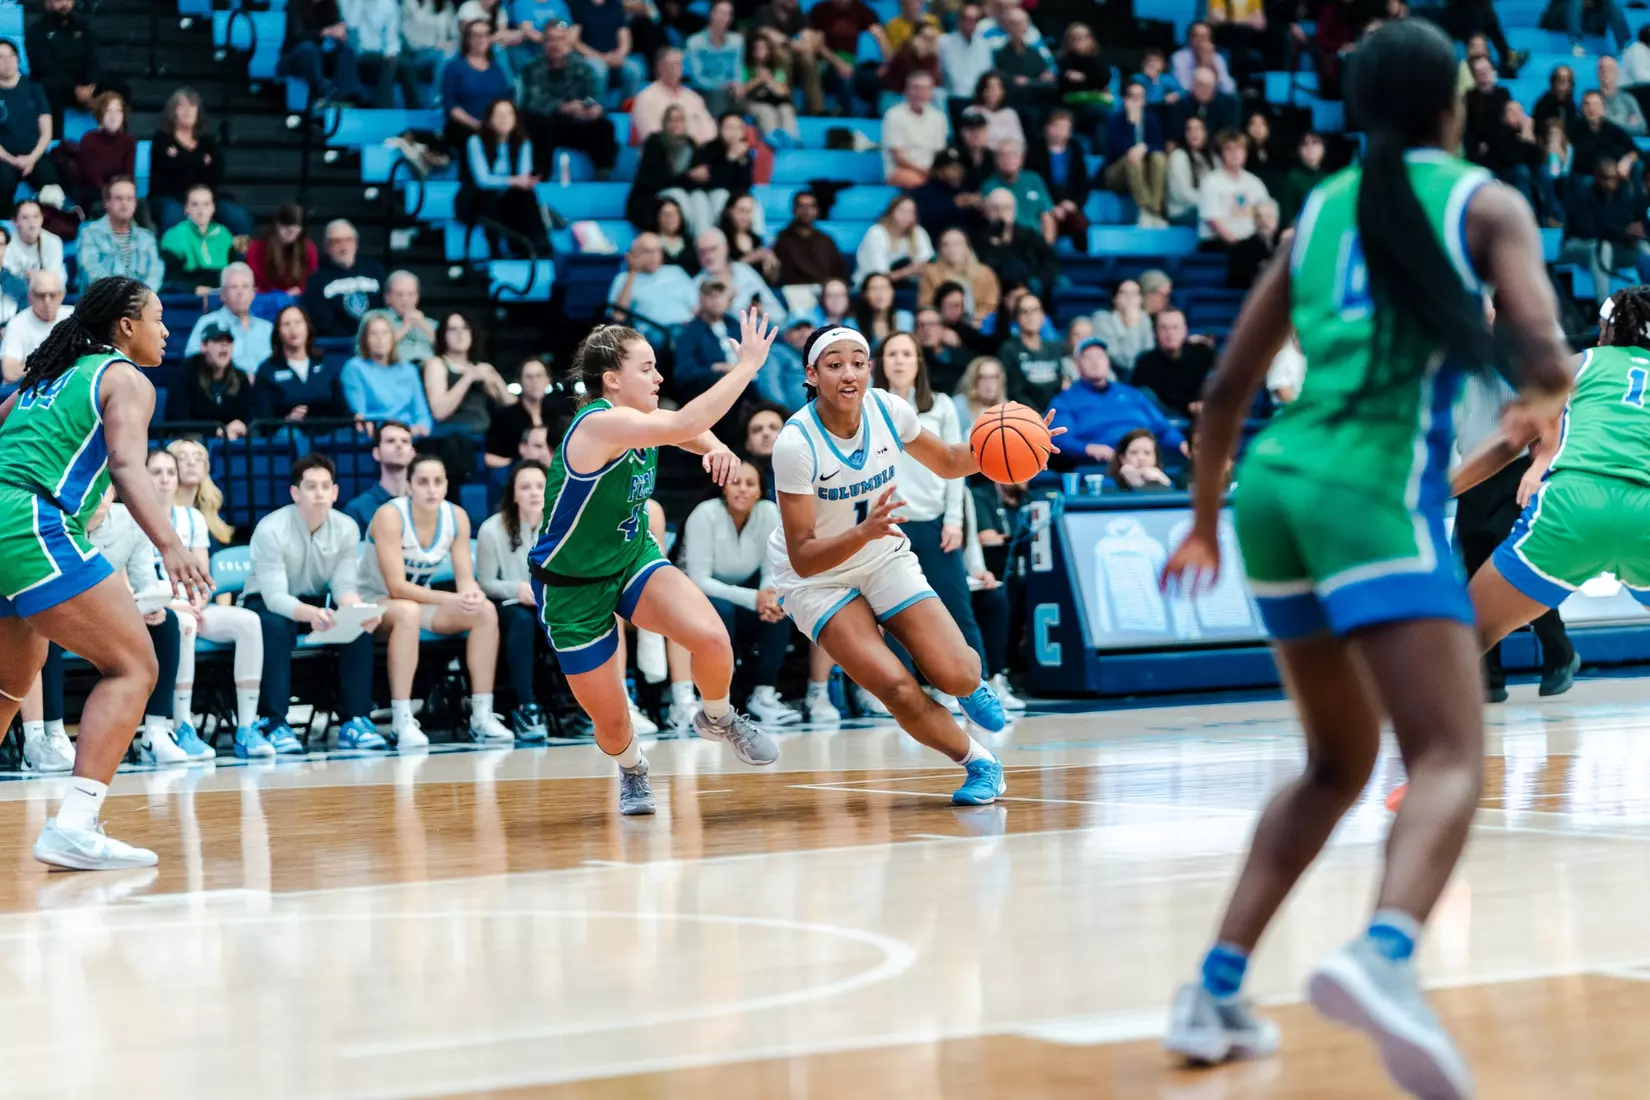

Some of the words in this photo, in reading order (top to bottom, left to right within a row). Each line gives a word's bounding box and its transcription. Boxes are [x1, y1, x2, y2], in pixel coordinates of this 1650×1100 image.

[1621, 366, 1648, 409] 1
[817, 465, 895, 501] COLUMBIA
[617, 503, 641, 542] 4
[853, 499, 869, 525] 1
[1034, 603, 1062, 667] C
